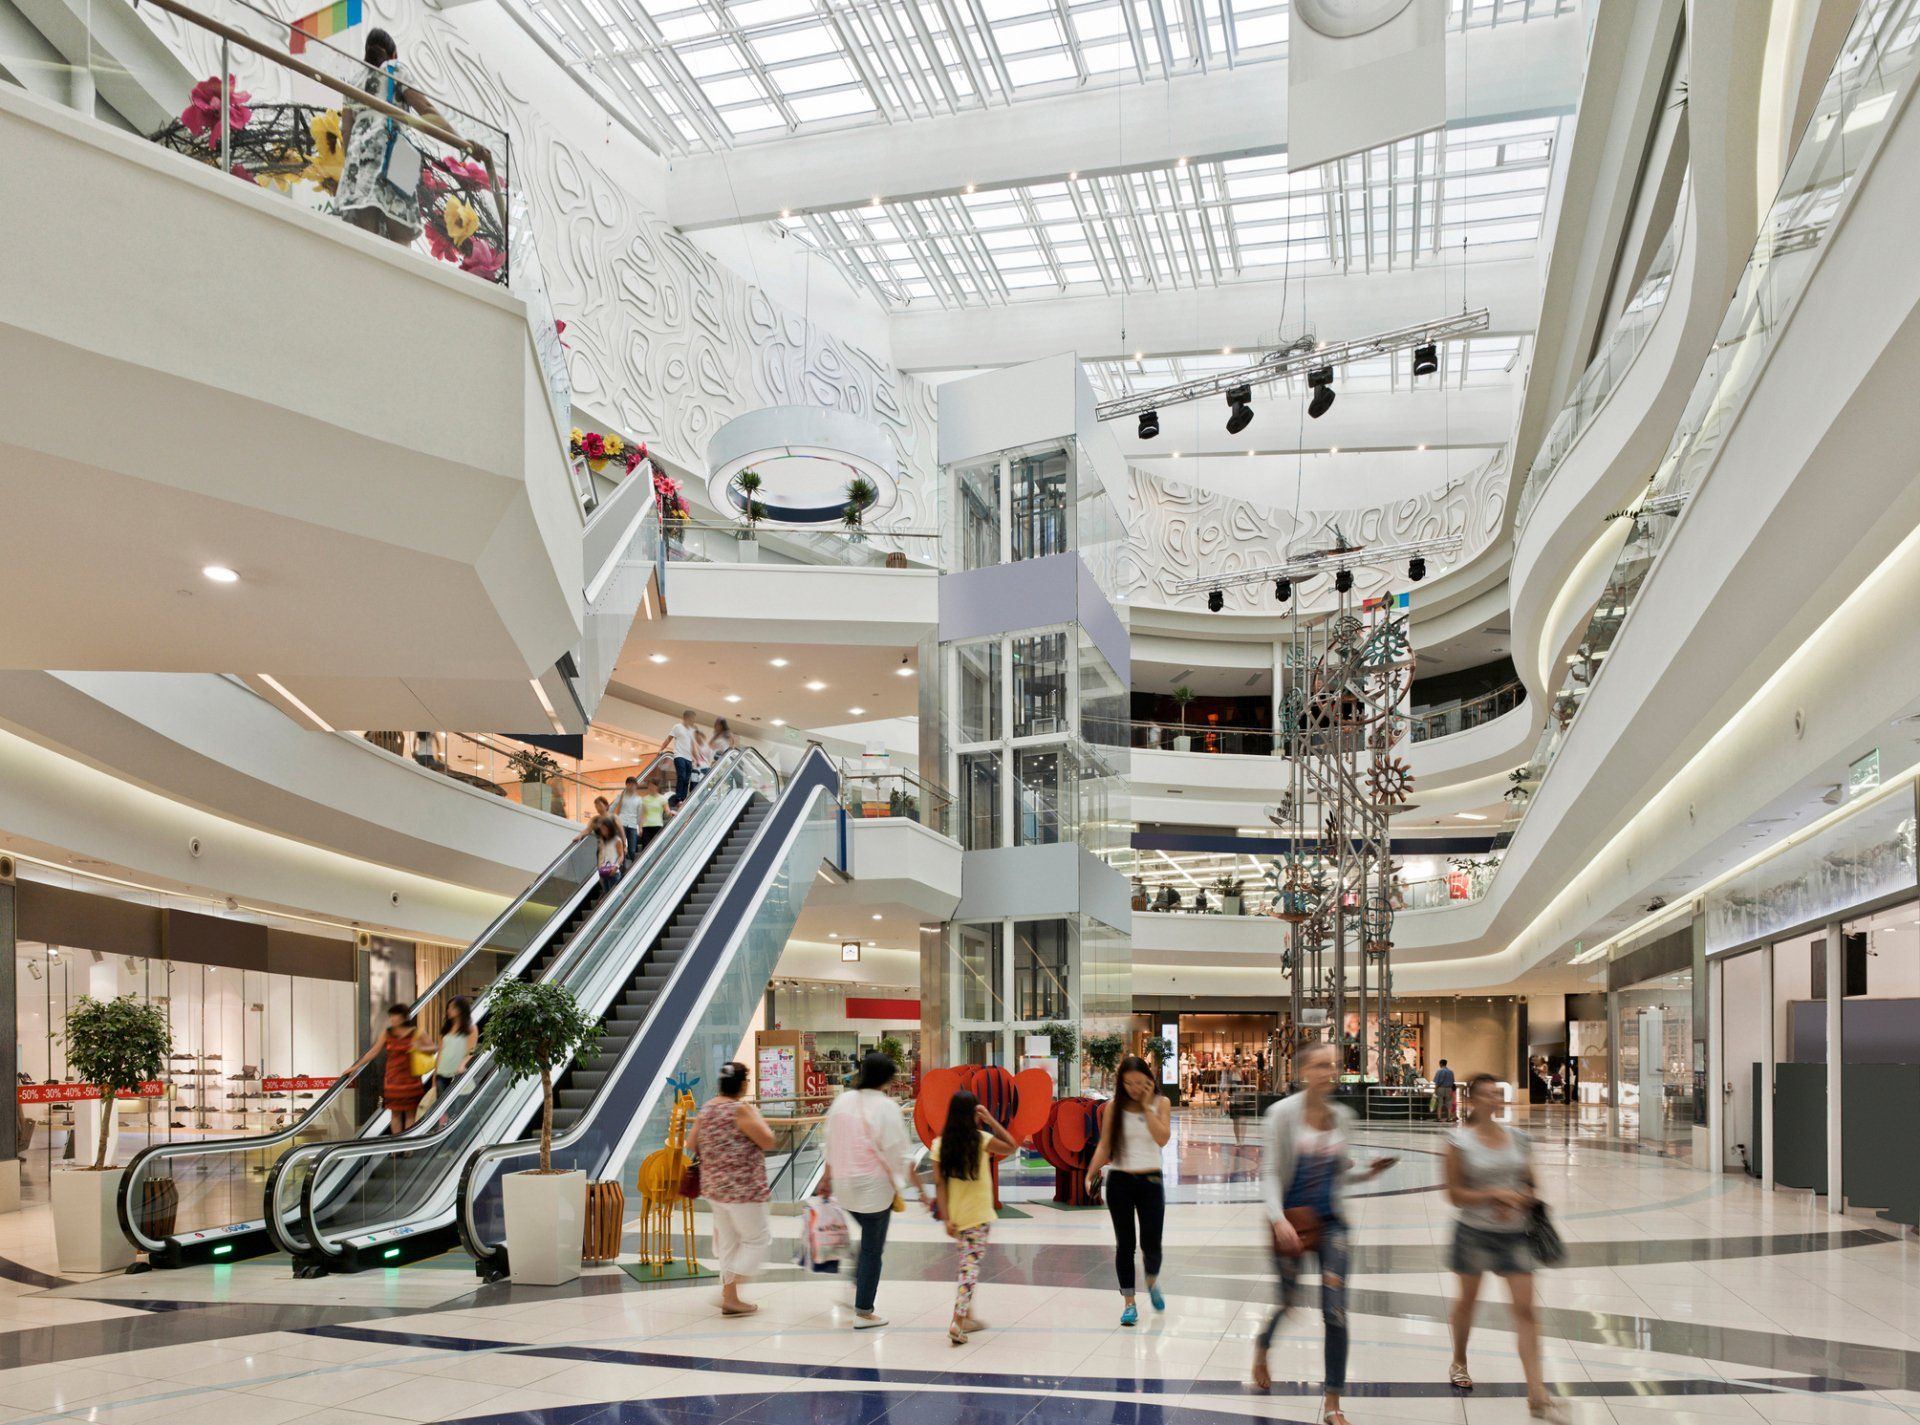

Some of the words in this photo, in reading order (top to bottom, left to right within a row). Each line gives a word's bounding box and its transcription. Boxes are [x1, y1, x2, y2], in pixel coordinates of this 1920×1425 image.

[19, 1089, 39, 1100] -50%
[43, 1088, 62, 1099] -30%
[63, 1087, 82, 1097] -40%
[143, 1084, 160, 1094] -50%
